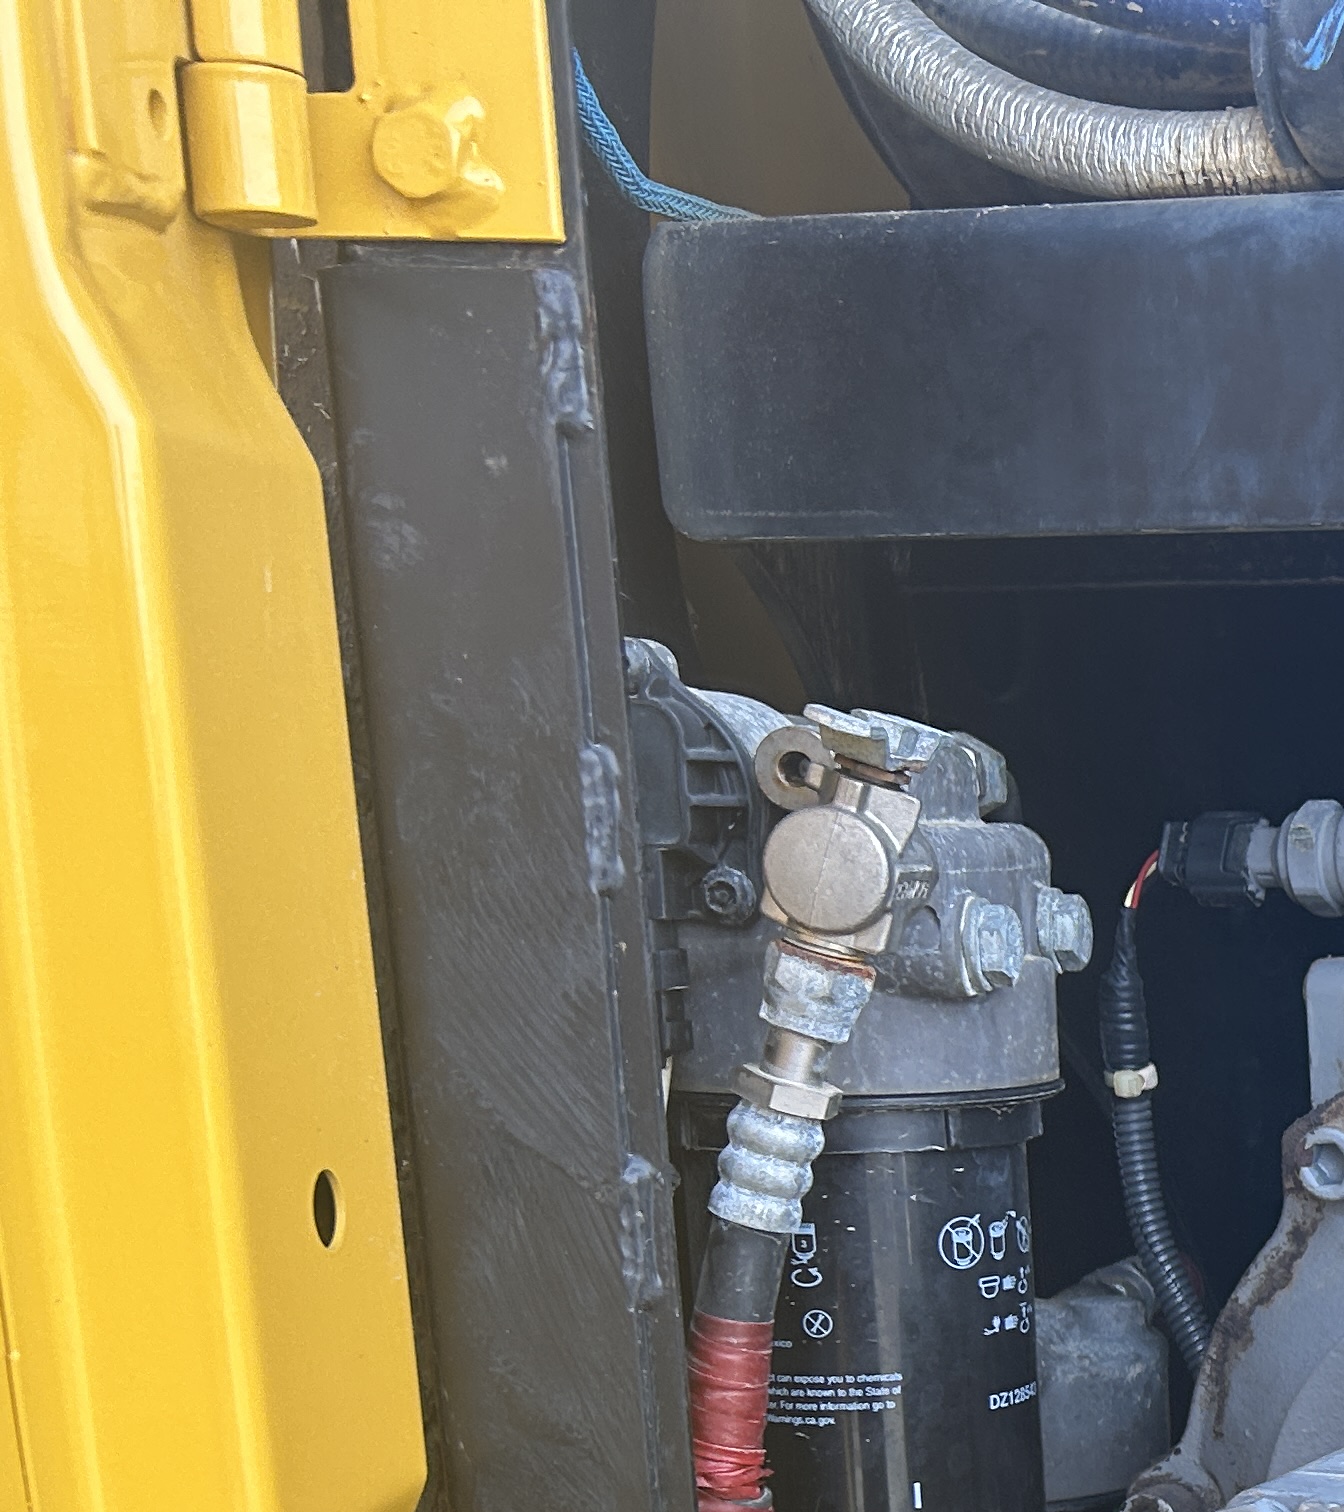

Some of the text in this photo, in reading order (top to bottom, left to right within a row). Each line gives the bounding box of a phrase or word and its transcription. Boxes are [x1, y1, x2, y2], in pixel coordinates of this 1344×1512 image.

[826, 1375, 844, 1385] you
[845, 1374, 856, 1383] to
[806, 1387, 836, 1397] known
[864, 1385, 890, 1397] State
[891, 1384, 902, 1395] of
[819, 1401, 871, 1411] information
[872, 1401, 885, 1412] go
[885, 1400, 896, 1409] to
